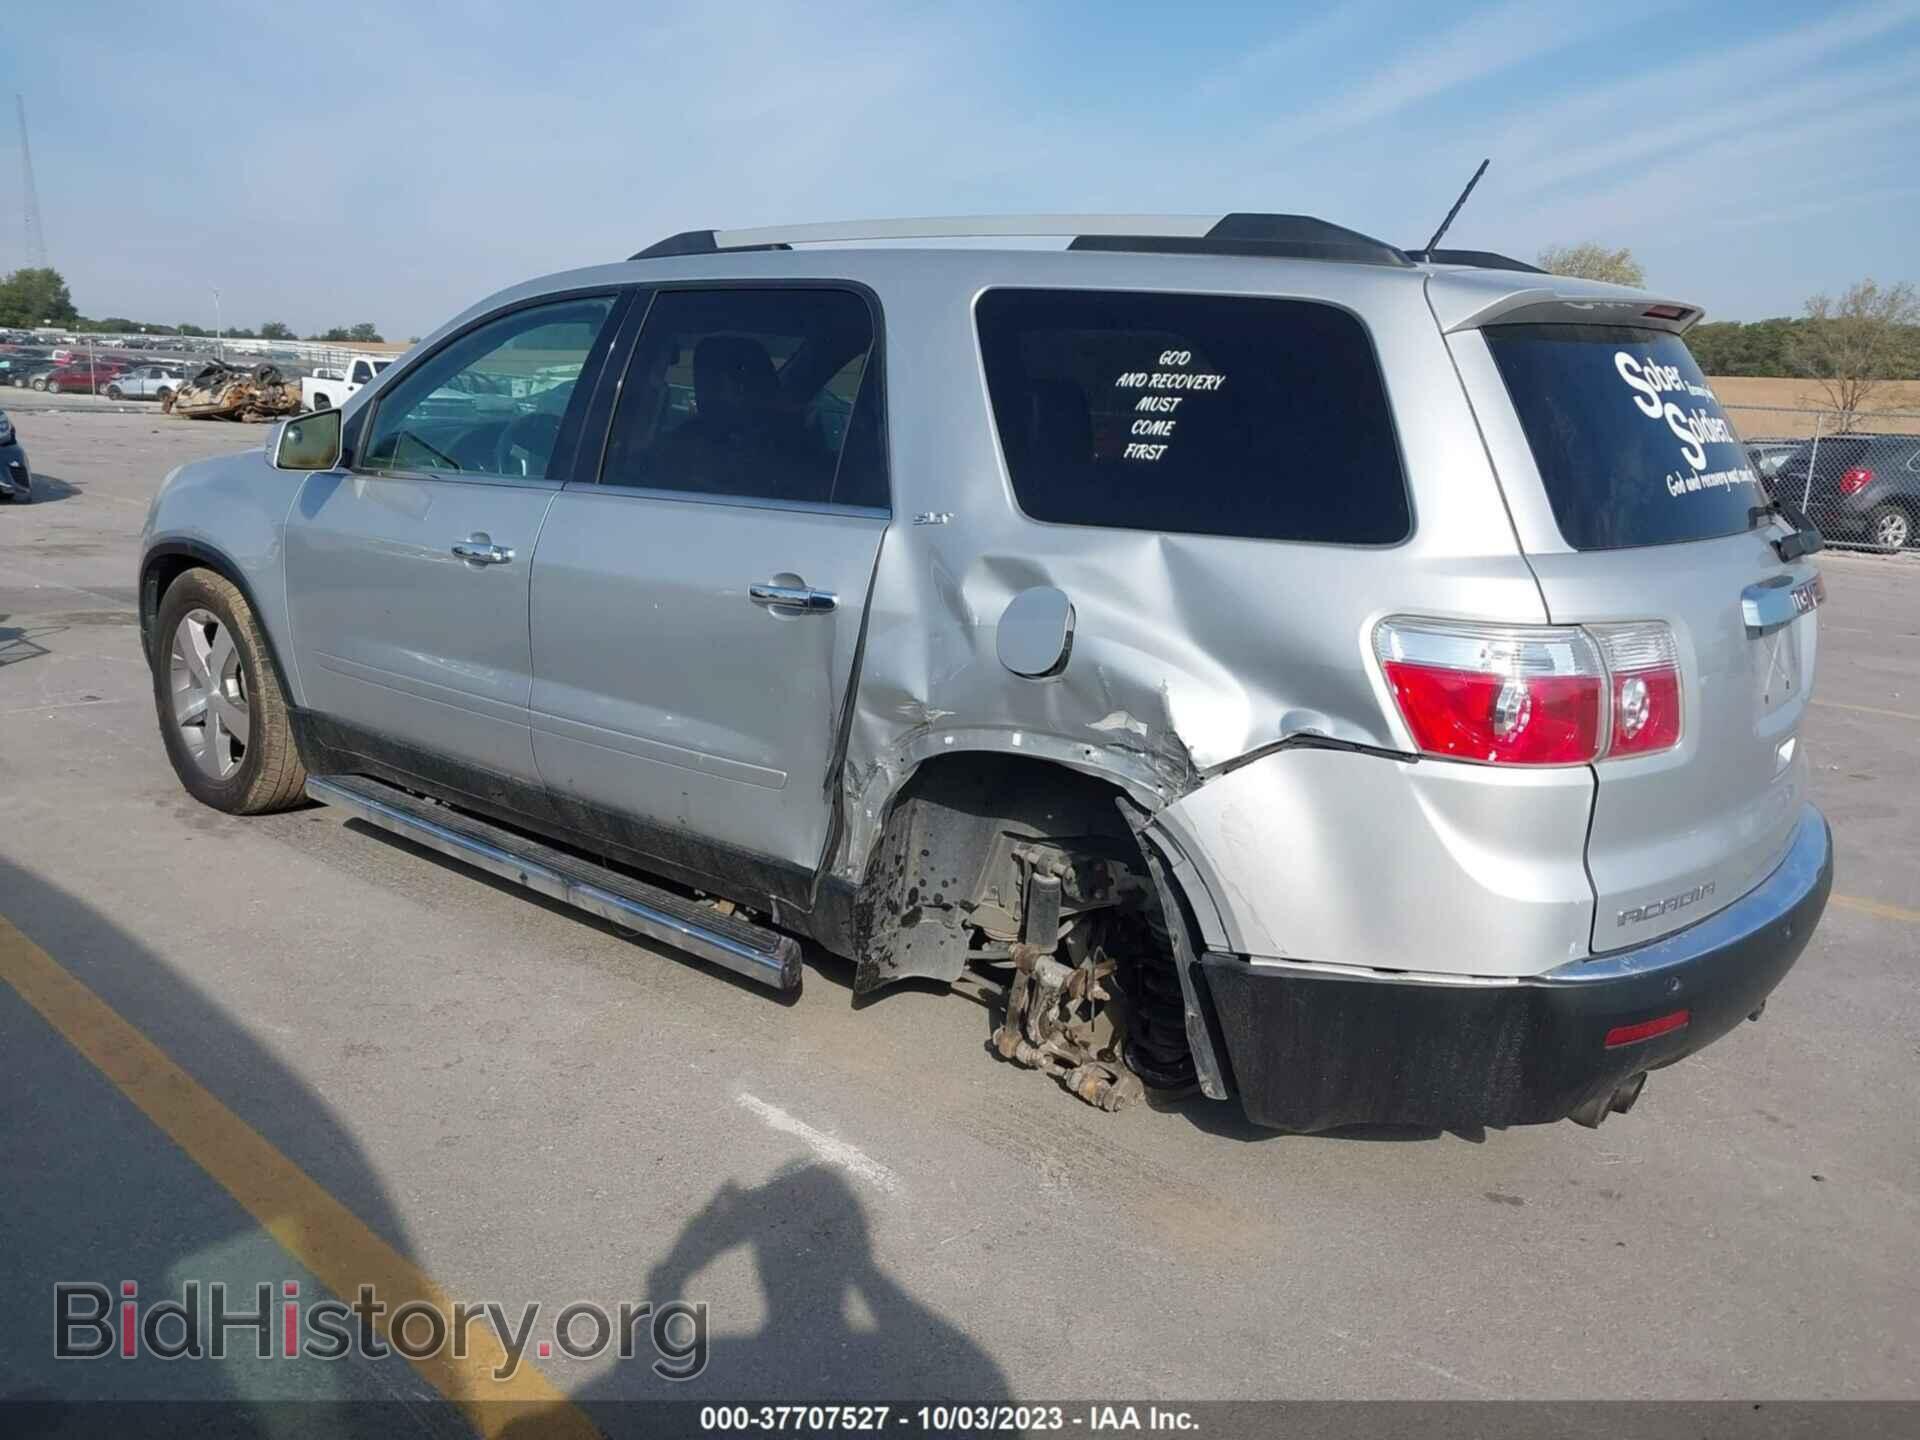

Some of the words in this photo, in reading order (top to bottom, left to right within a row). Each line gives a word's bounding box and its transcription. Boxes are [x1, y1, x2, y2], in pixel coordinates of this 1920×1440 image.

[1158, 350, 1191, 366] GOD
[1115, 372, 1147, 388] AND
[1148, 373, 1226, 390] RECOVERY
[1614, 351, 1686, 419] Sober
[1135, 396, 1182, 413] MUST
[1131, 419, 1176, 436] COME
[1123, 443, 1168, 460] FIRST
[1666, 470, 1686, 497] God
[1616, 880, 1716, 927] ACADIA
